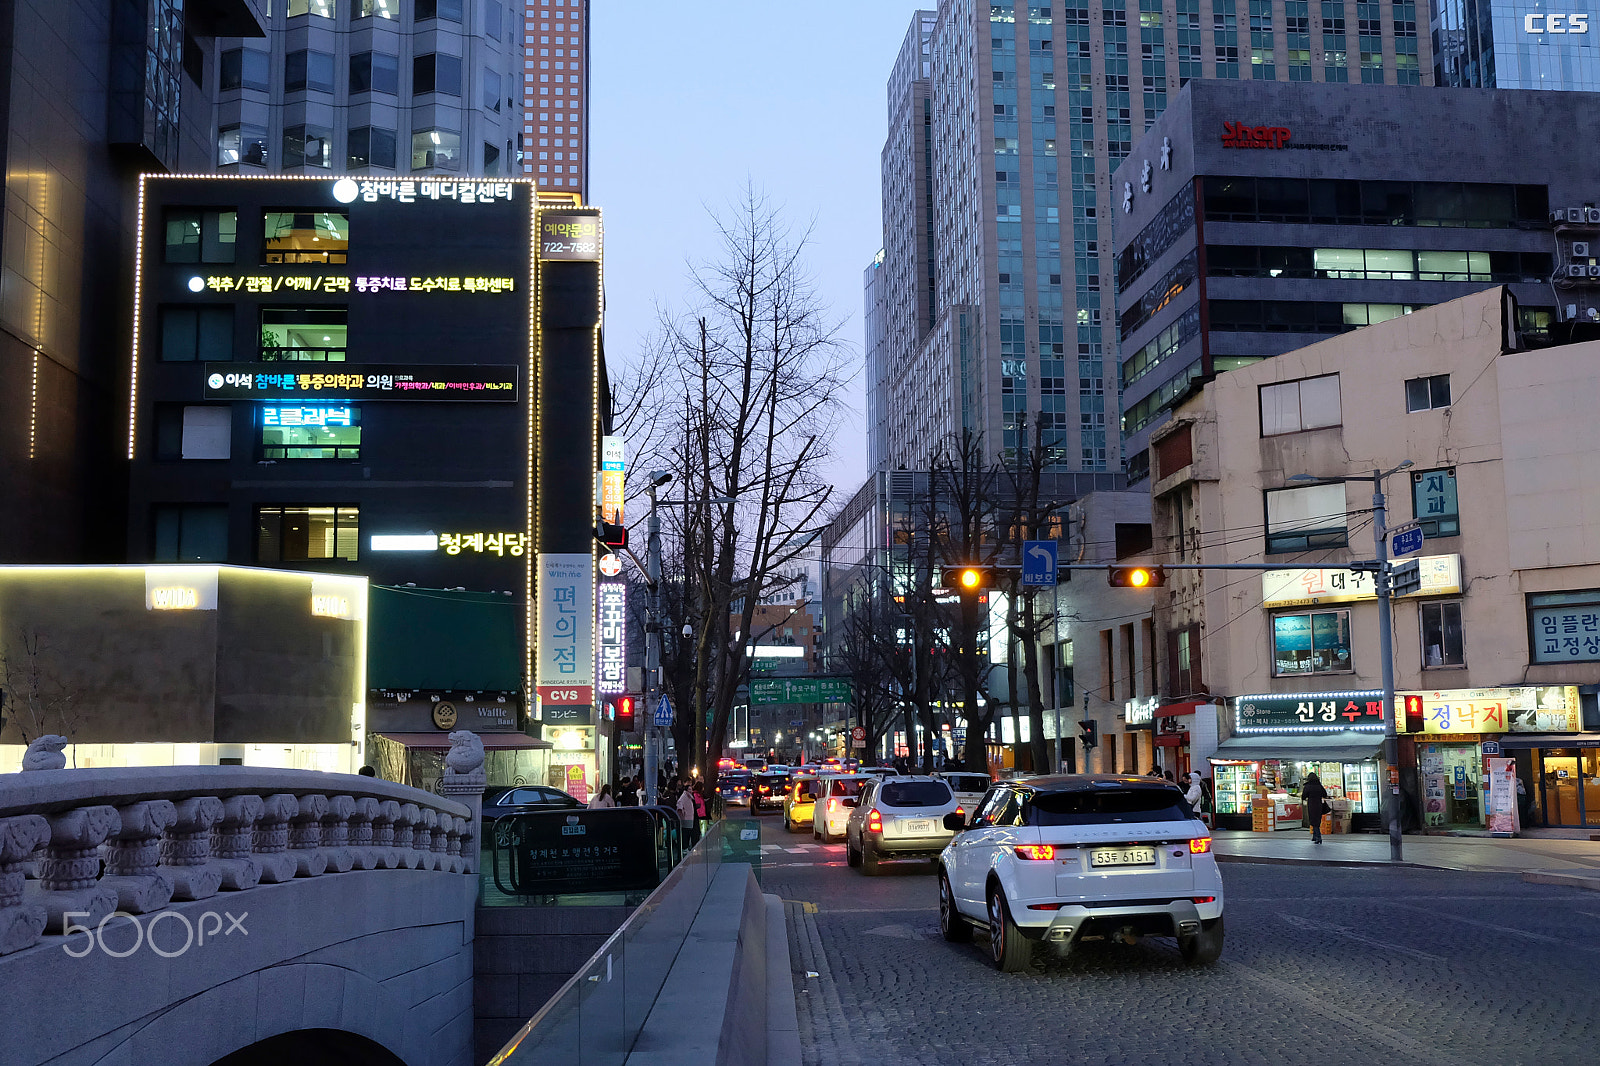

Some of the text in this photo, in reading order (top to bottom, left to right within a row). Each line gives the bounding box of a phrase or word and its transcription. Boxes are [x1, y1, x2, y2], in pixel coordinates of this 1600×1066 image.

[1221, 121, 1291, 148] Sharp
[360, 181, 513, 203] 참바른 메디컬센터
[543, 223, 596, 238] 예약문의
[543, 242, 596, 253] 722-7582
[355, 276, 407, 292] 통증치료
[409, 276, 461, 292] 도수치료
[463, 277, 514, 293] 특화센터
[226, 373, 393, 390] 이석 참바른 통증의학과 의원
[440, 532, 528, 556] 청계식당
[1024, 573, 1053, 583] 비보호
[553, 586, 576, 674] 편의점
[1541, 613, 1599, 634] 임플란
[1543, 636, 1600, 656] 교정상
[550, 690, 578, 701] CVS
[477, 707, 507, 718] Waffle
[550, 709, 578, 719] コンビニ
[1295, 700, 1384, 723] 신성수퍼
[529, 848, 557, 860] 청계천
[1122, 851, 1149, 863] 6151
